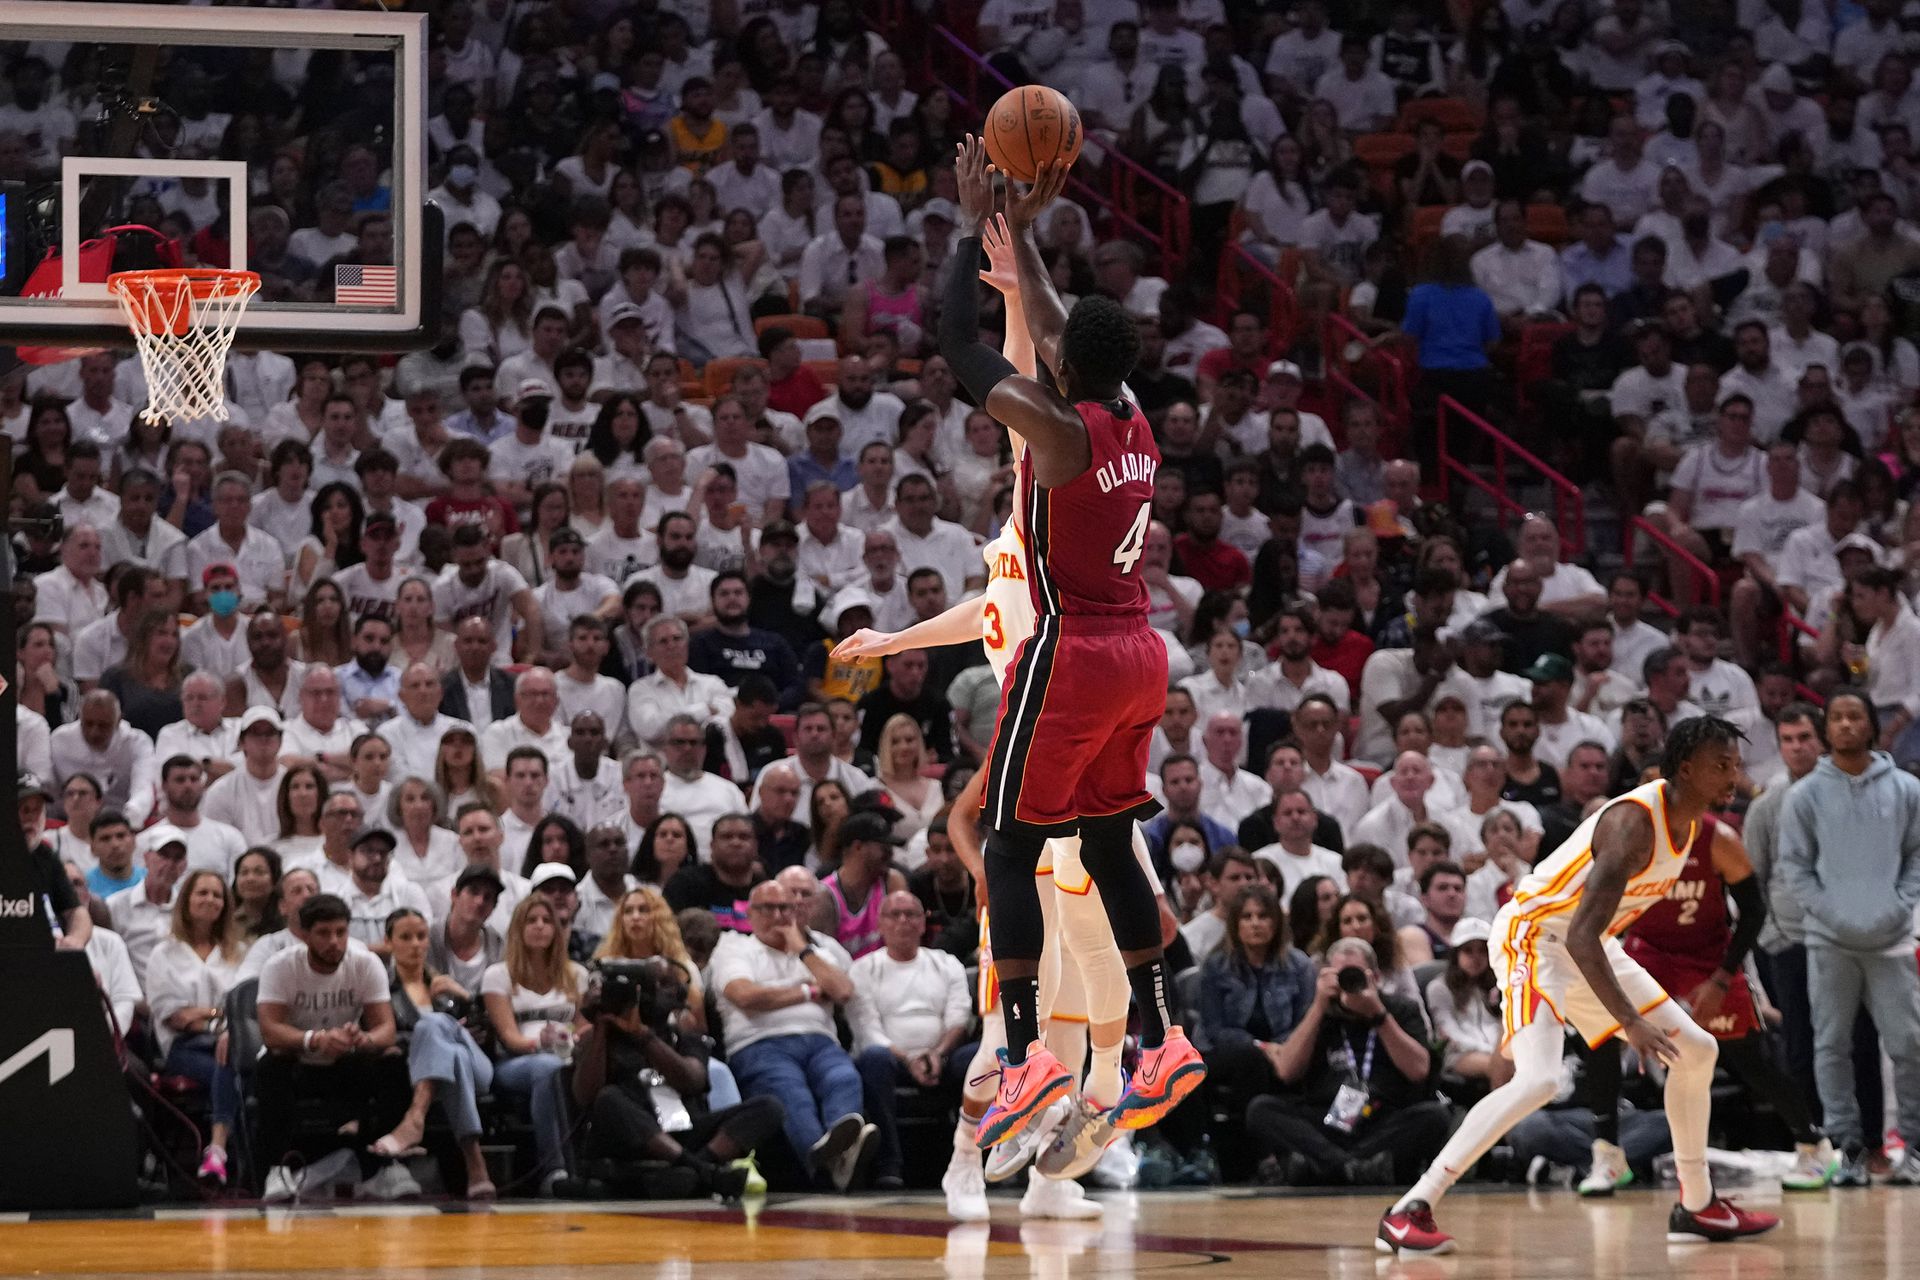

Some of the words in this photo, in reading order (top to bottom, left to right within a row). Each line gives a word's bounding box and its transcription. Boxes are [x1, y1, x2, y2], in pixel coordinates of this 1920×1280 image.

[1113, 501, 1151, 575] 4
[984, 602, 1005, 650] 3
[1677, 899, 1699, 925] 2
